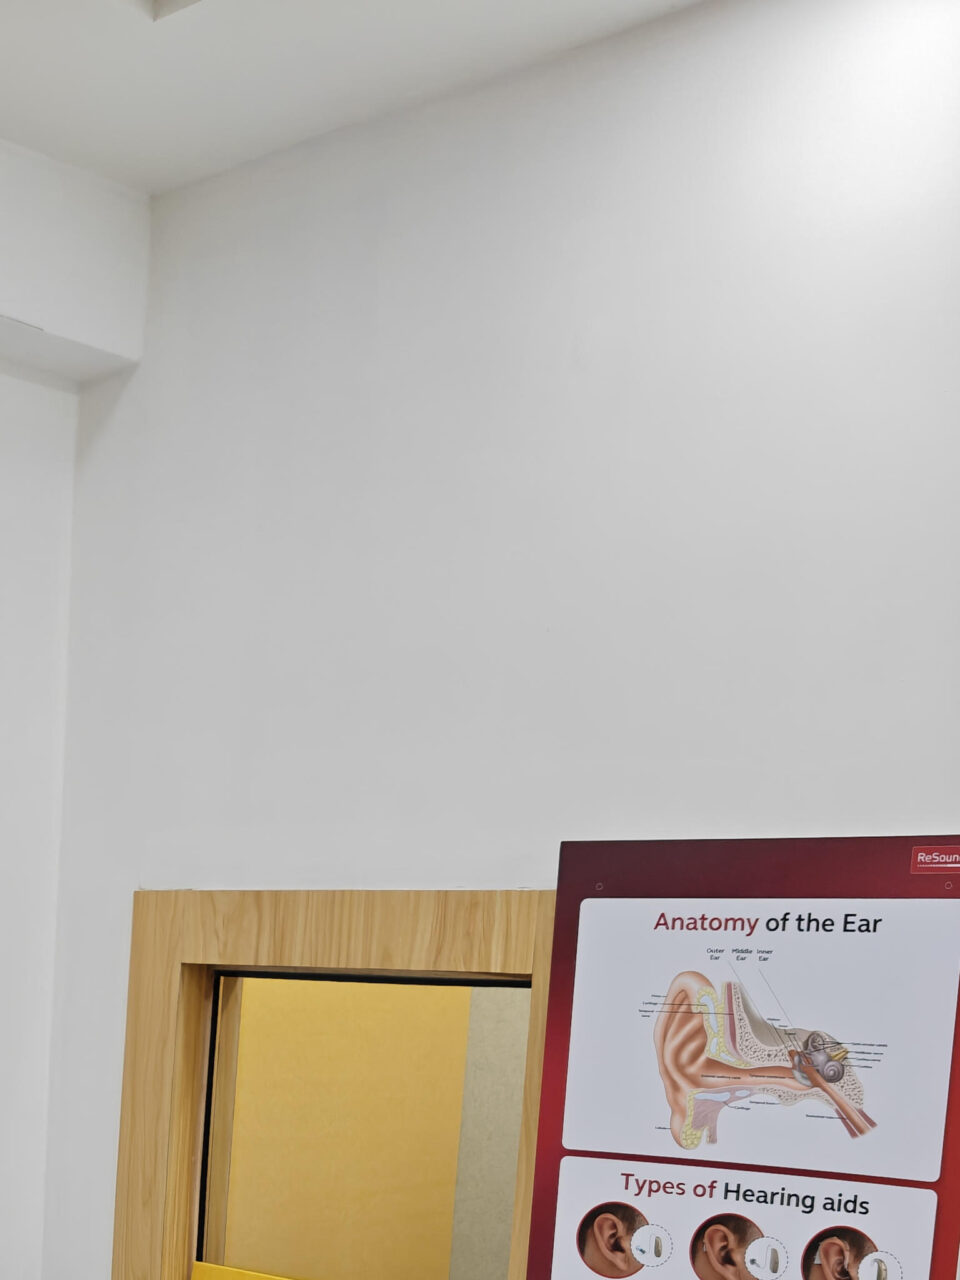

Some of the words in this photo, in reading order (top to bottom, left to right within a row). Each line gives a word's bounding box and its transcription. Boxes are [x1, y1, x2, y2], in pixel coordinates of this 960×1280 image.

[654, 912, 759, 937] Anatomy
[765, 912, 789, 932] of
[795, 912, 835, 933] the
[841, 913, 883, 934] Ear
[620, 1173, 686, 1197] Types
[692, 1179, 718, 1199] of
[722, 1183, 815, 1214] Hearing
[822, 1194, 870, 1215] aids
